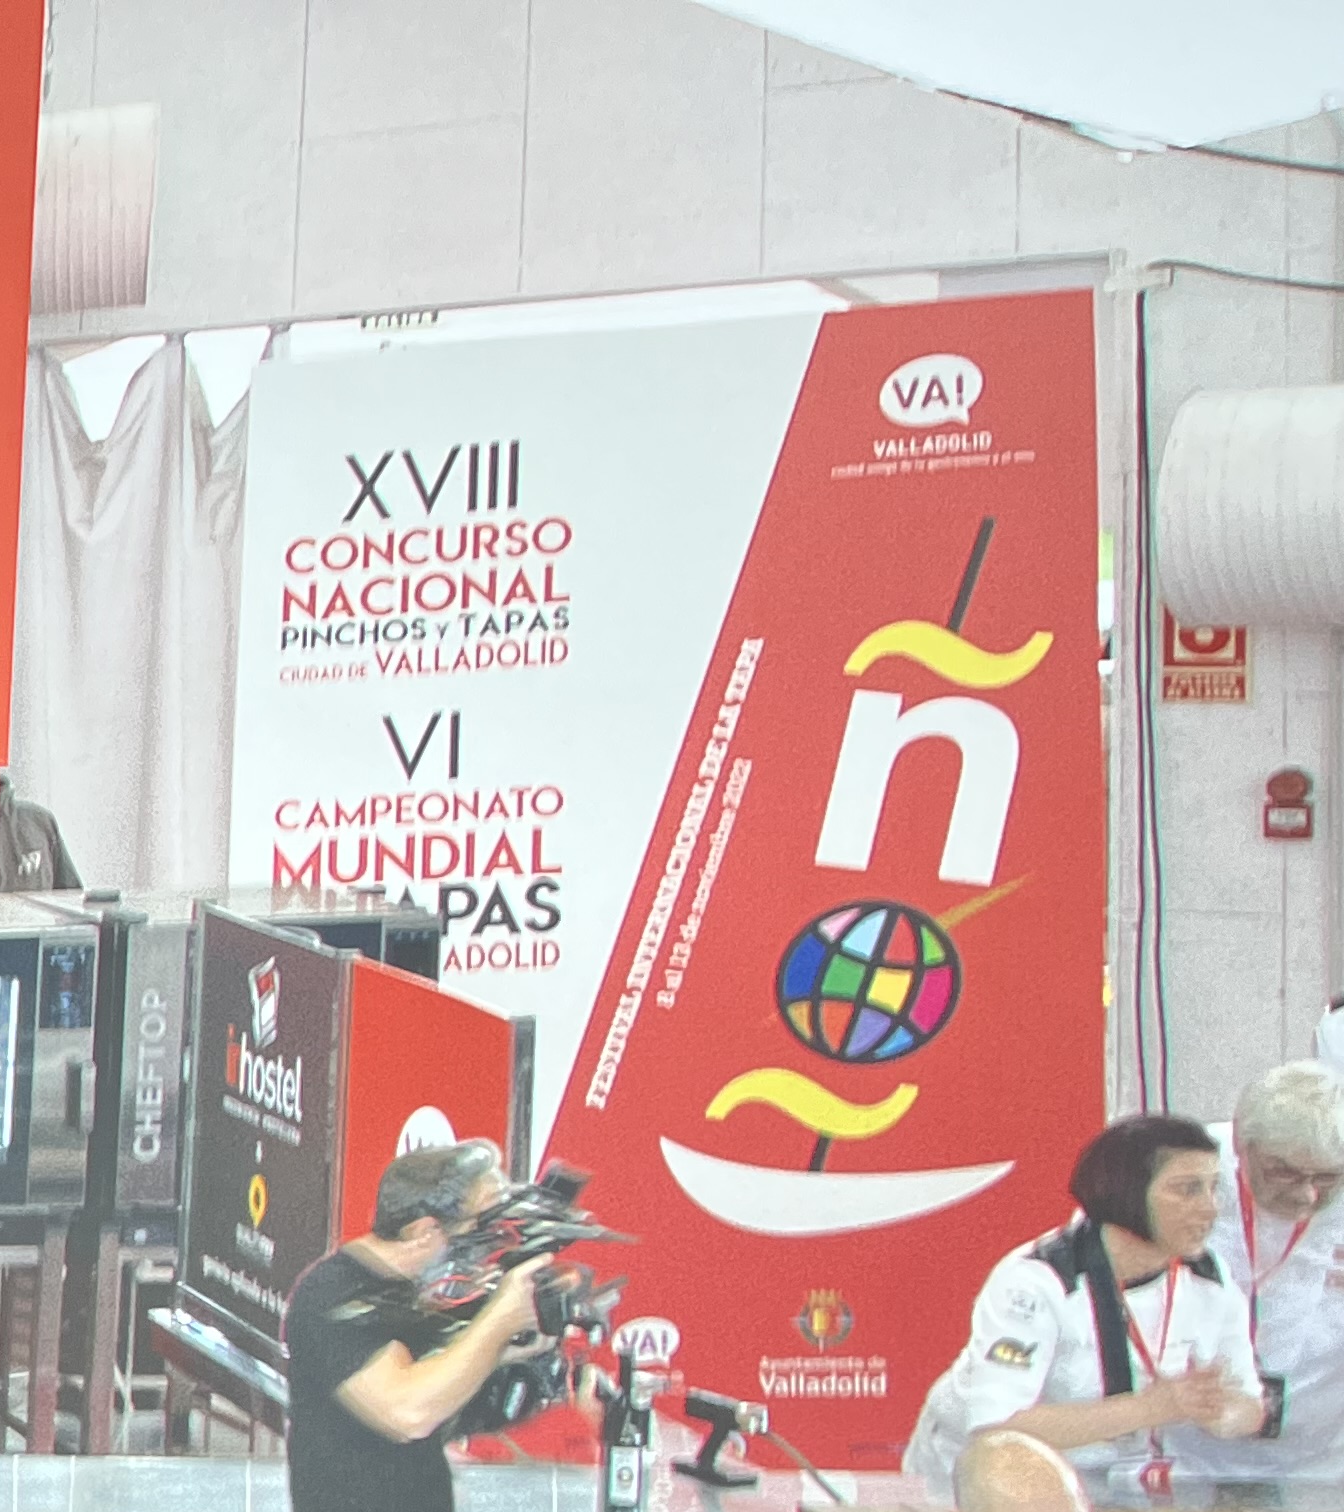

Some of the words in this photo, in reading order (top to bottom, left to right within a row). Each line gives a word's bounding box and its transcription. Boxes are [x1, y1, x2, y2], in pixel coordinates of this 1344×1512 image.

[893, 373, 964, 409] VA!
[873, 430, 992, 460] VALLADOLID
[342, 438, 519, 523] XVIII
[285, 516, 572, 574] CONCURSO
[282, 562, 570, 623] NACIONAL
[281, 617, 427, 652] PINCHOS
[458, 606, 571, 638] TAPAS
[280, 663, 343, 684] CIUDAD
[348, 661, 369, 679] DE
[375, 636, 569, 676] VALLADOLID
[382, 710, 461, 781] VI
[274, 785, 564, 830] CAMPEONATO
[272, 825, 562, 888] MUNDIAL
[443, 939, 561, 973] ADOLID
[132, 988, 167, 1163] CHEFTOP
[759, 1372, 888, 1398] Valladolid
